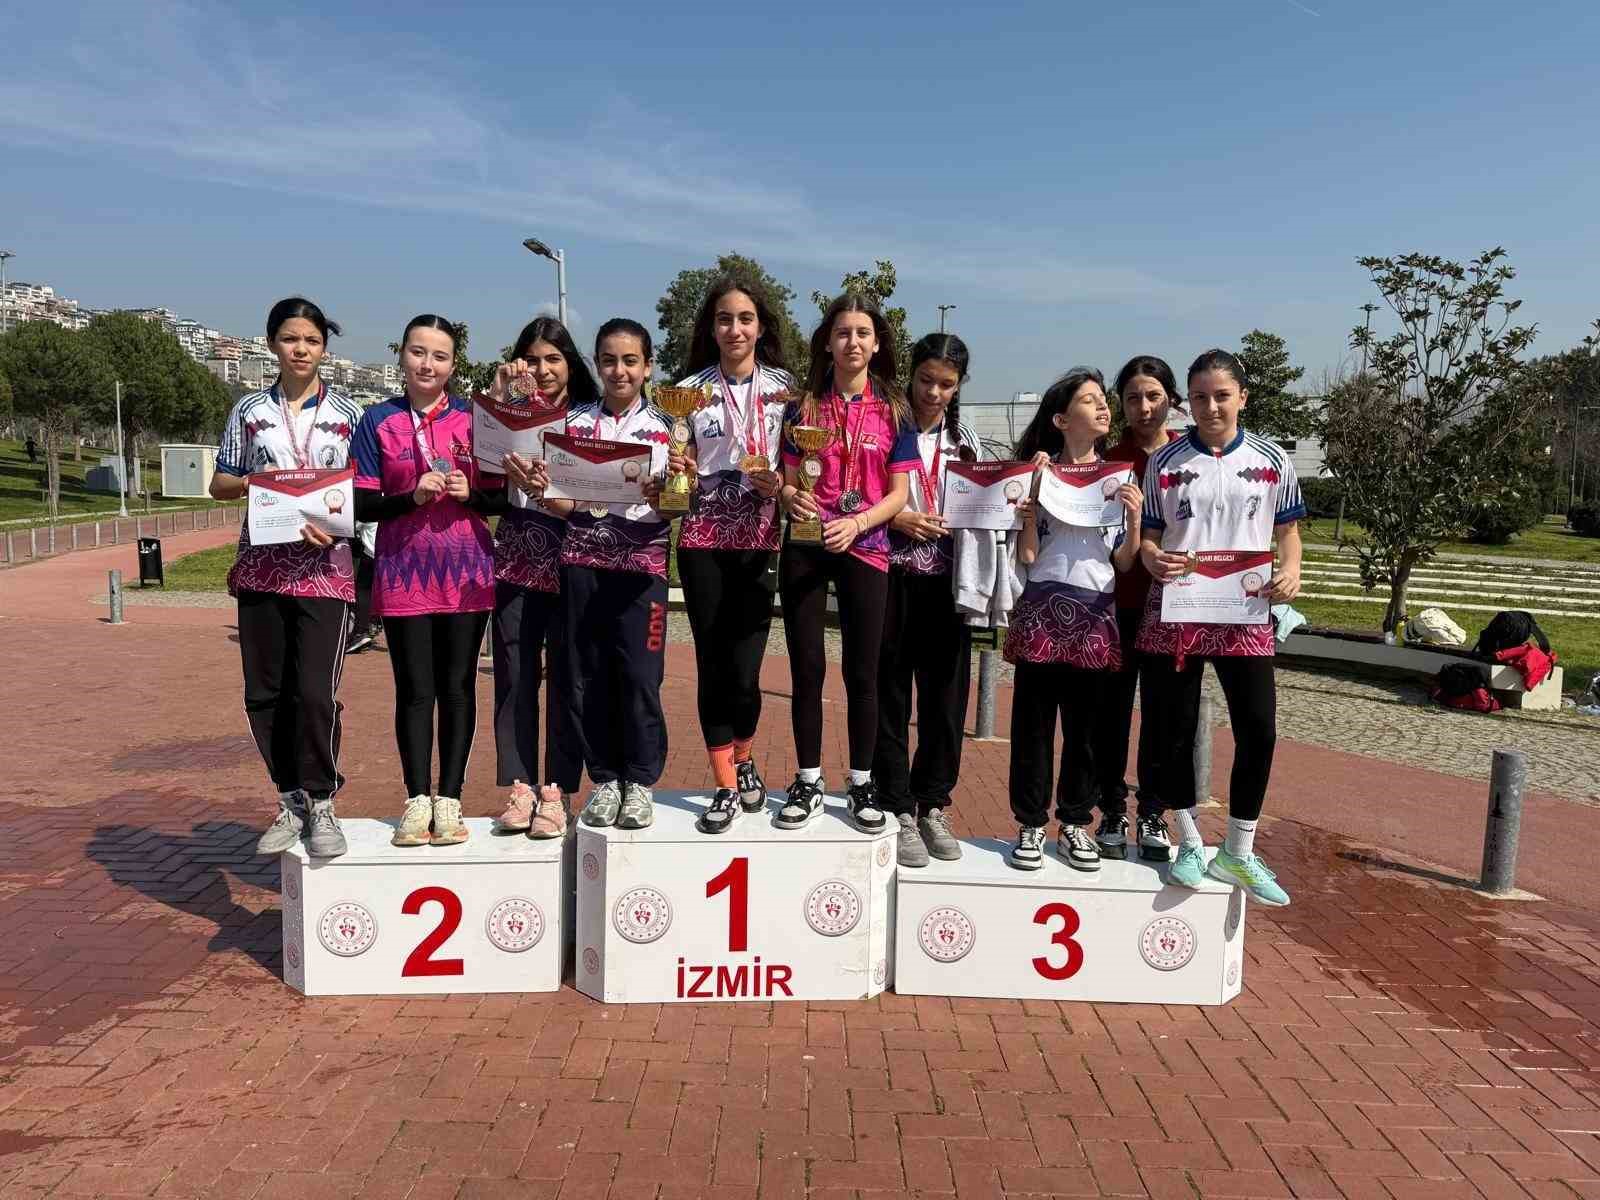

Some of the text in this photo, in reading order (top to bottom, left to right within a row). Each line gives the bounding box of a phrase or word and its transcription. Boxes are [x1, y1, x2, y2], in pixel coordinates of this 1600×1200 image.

[401, 886, 464, 977] 2
[706, 857, 748, 952] 1
[1031, 902, 1084, 980] 3
[677, 956, 794, 998] İZMİR
